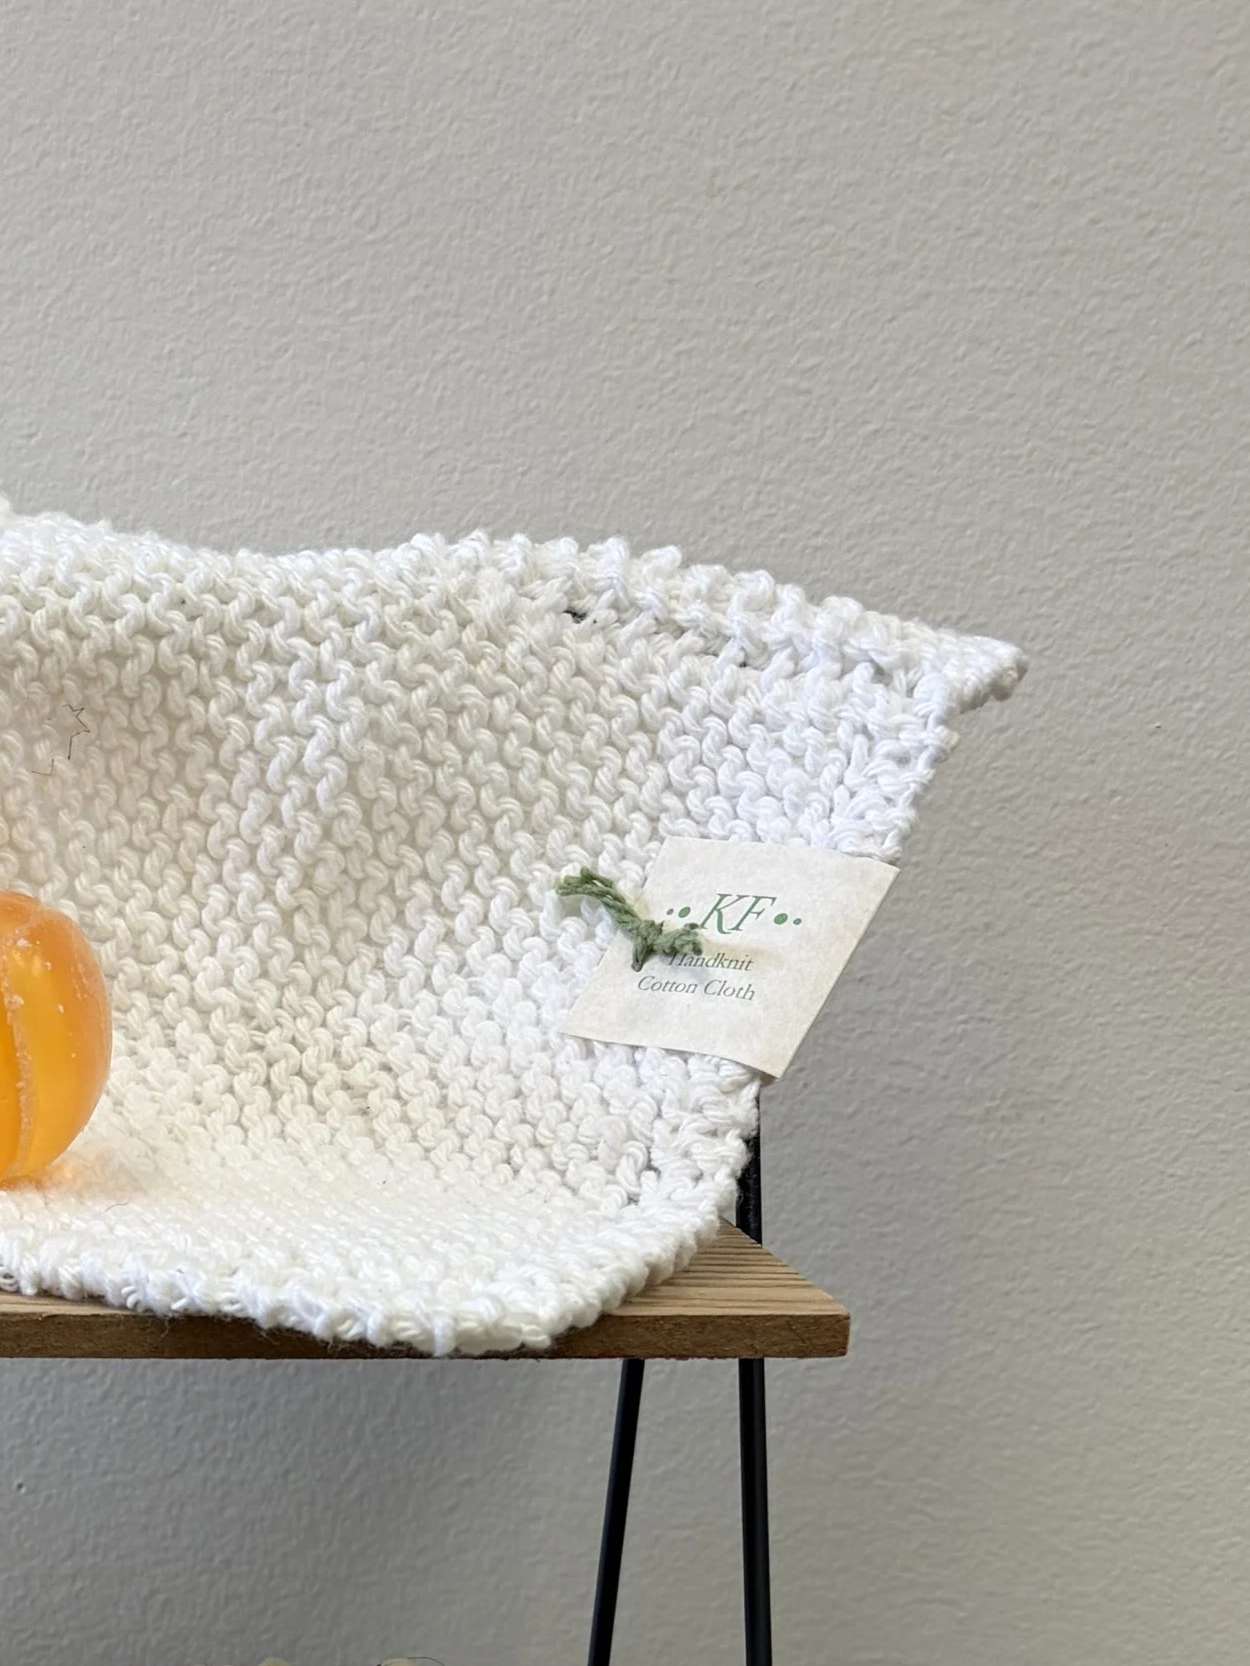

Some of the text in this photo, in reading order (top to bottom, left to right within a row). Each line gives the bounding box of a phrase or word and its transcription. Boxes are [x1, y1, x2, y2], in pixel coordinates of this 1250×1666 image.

[699, 893, 777, 934] KF
[637, 975, 756, 1001] Cotton Cloth
